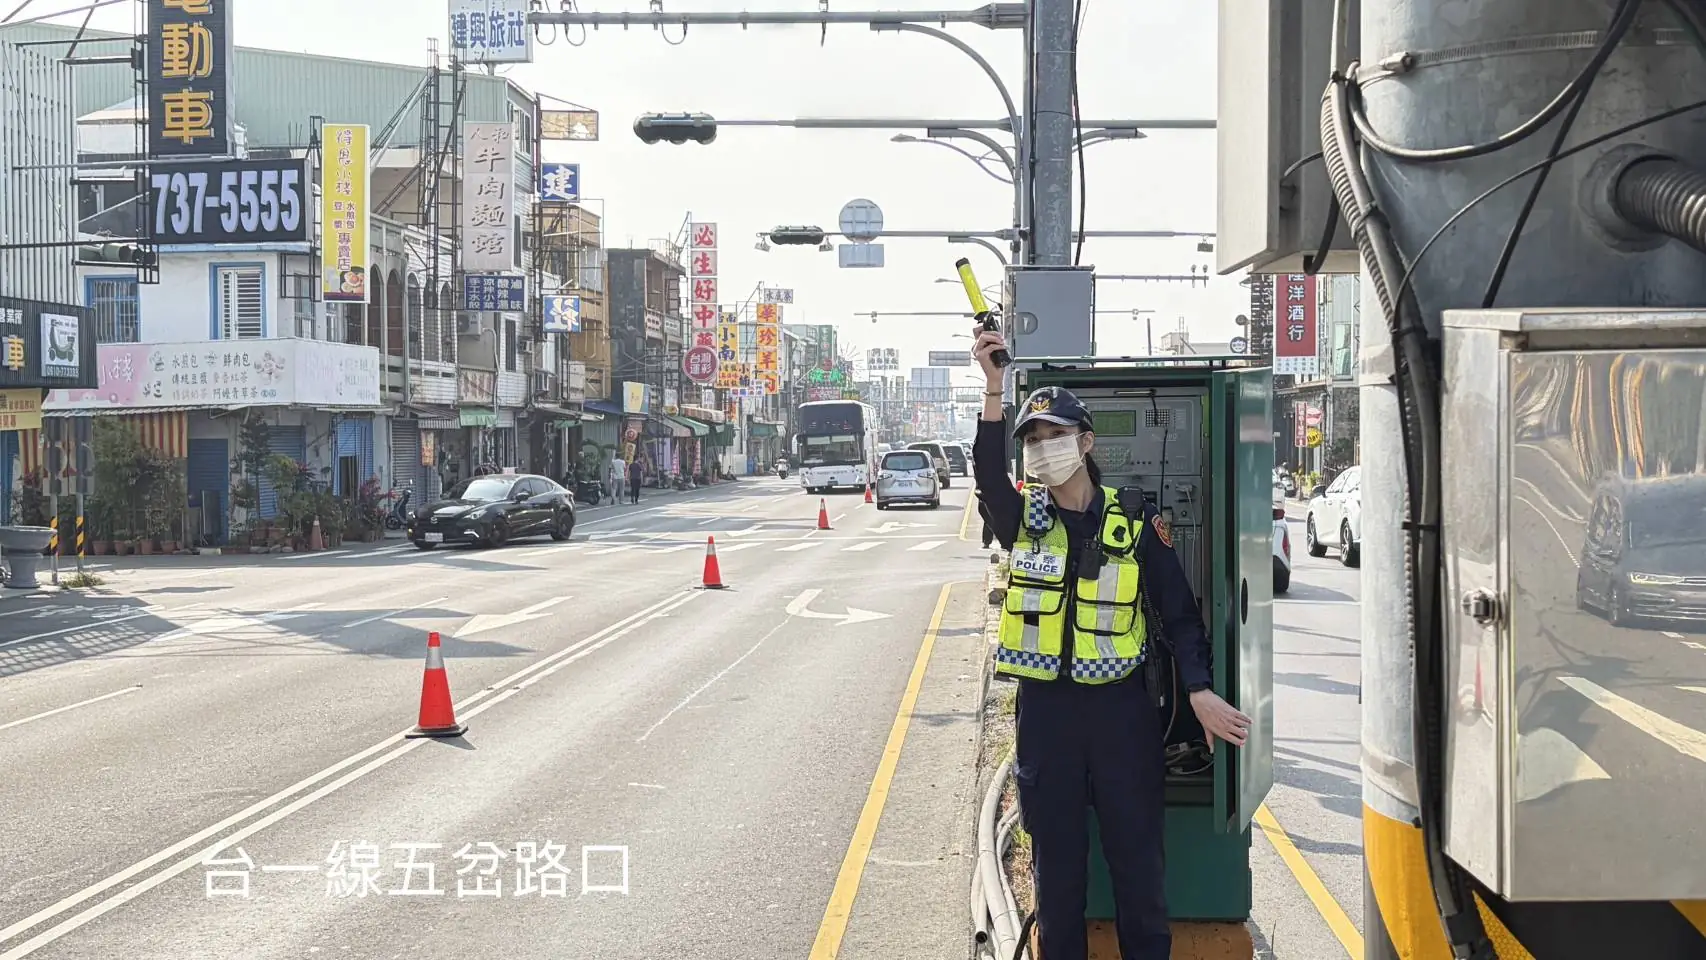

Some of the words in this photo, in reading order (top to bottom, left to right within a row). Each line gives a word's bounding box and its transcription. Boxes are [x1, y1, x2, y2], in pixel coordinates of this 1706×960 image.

[451, 10, 525, 49] 建興旅社
[162, 0, 214, 144] 動車
[543, 164, 576, 200] 建
[151, 169, 300, 235] 737-5555
[2, 334, 25, 371] 車
[1016, 560, 1058, 573] POLICE
